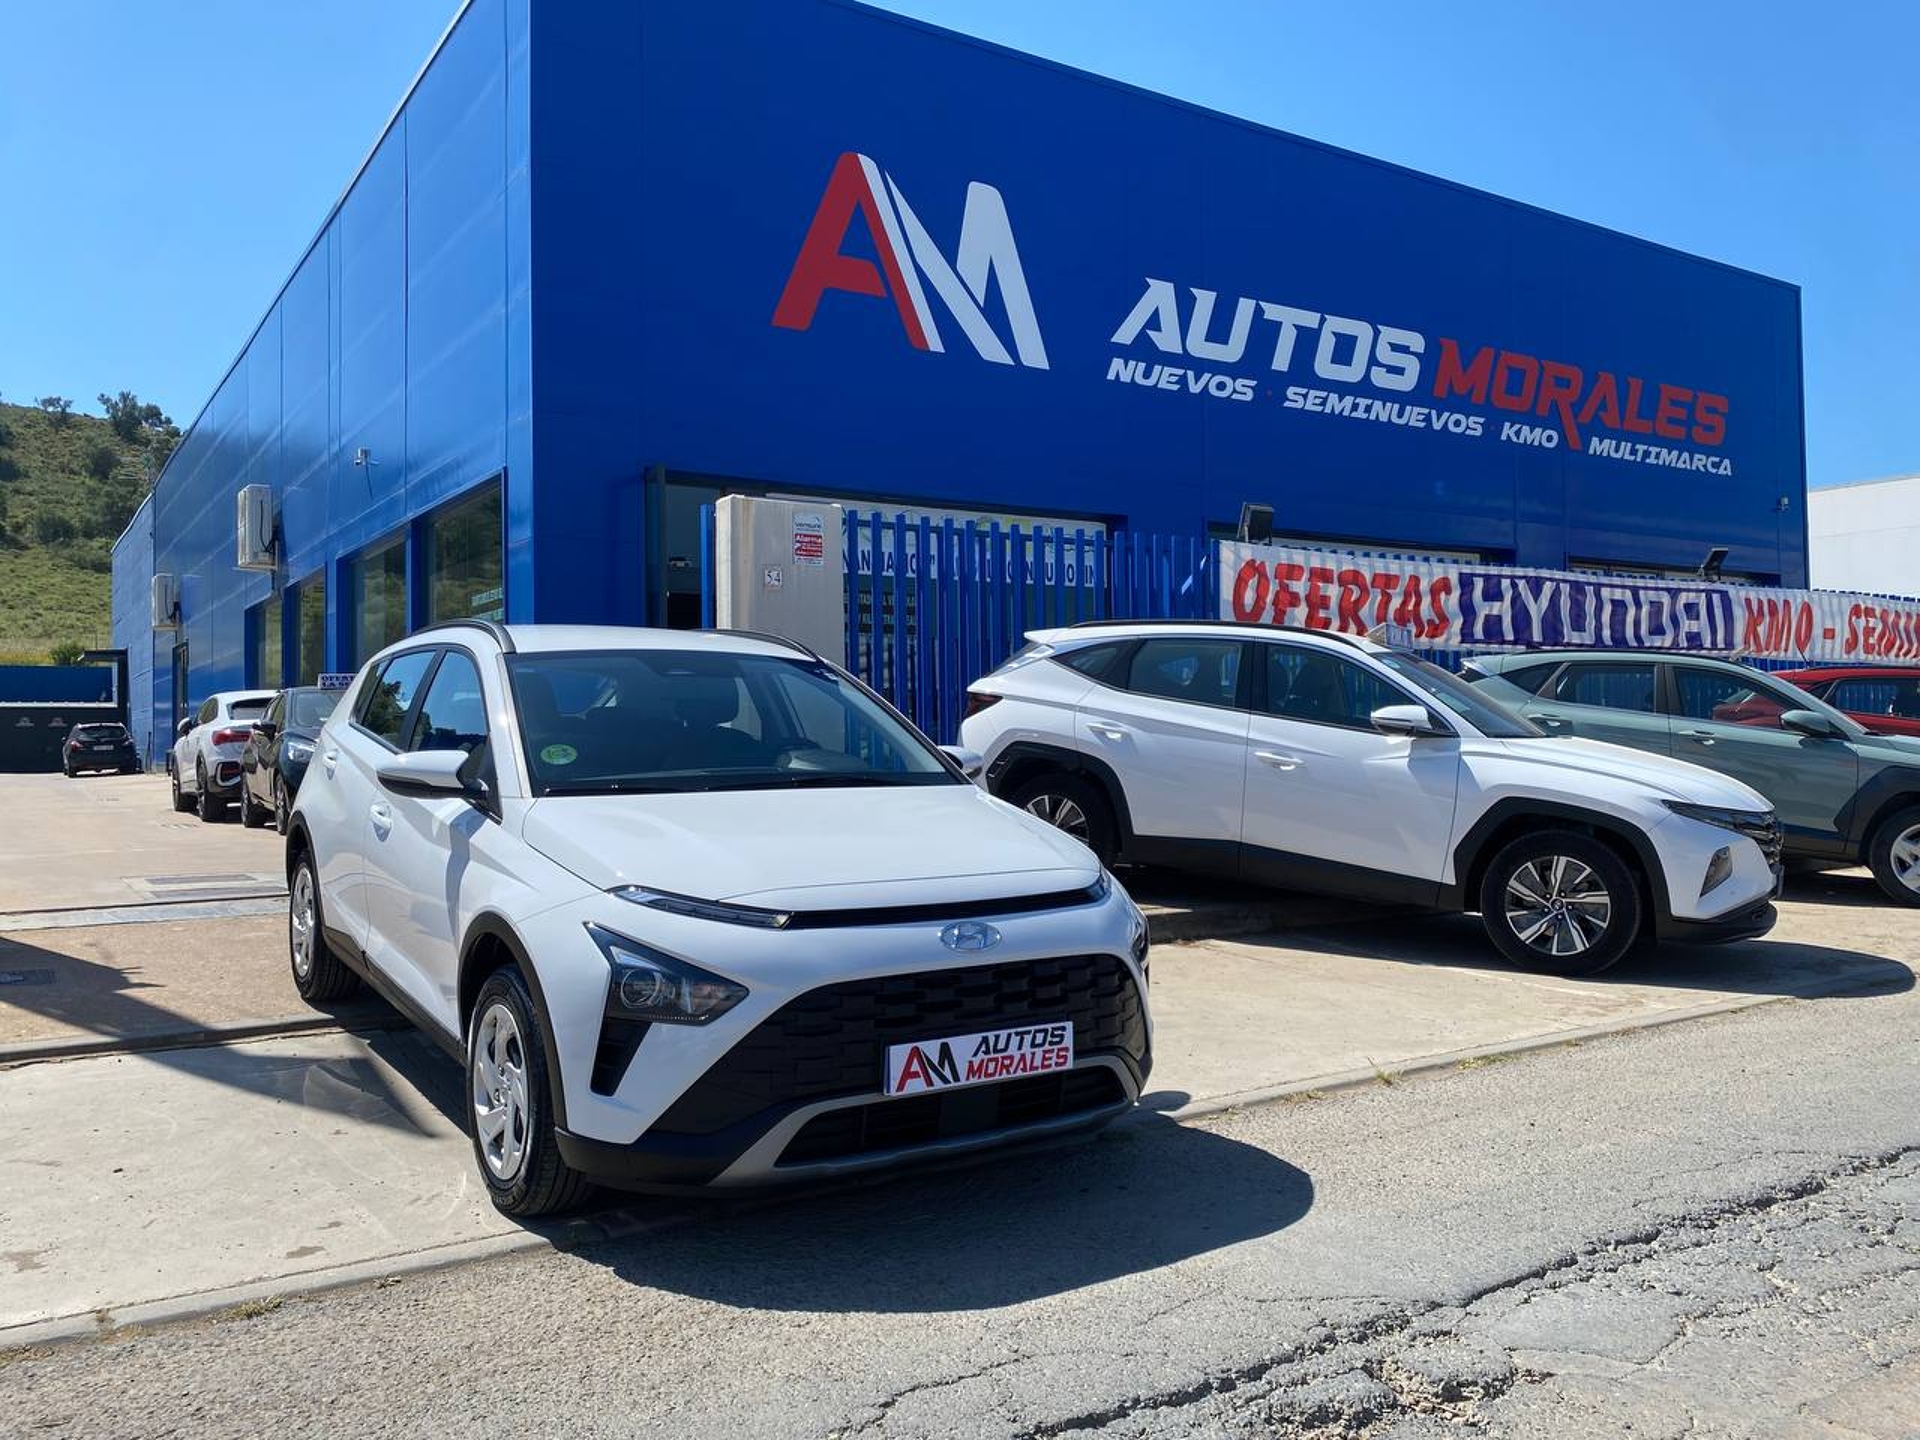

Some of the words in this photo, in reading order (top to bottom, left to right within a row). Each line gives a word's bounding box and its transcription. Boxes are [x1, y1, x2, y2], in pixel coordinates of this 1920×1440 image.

[774, 152, 1049, 369] AM
[1111, 278, 1425, 391] AUTOS
[1434, 338, 1729, 450] MORALES
[1107, 357, 1258, 401] NUEVOS
[1283, 386, 1485, 436] SEMINUEVOS
[1588, 436, 1732, 476] MULTIMARCA
[1232, 558, 1453, 639] OFERTAS
[1473, 576, 1724, 648] HYUNDAI
[896, 1042, 960, 1093] AM
[966, 1047, 1070, 1081] MORALES
[972, 1026, 1066, 1058] AUTOS
